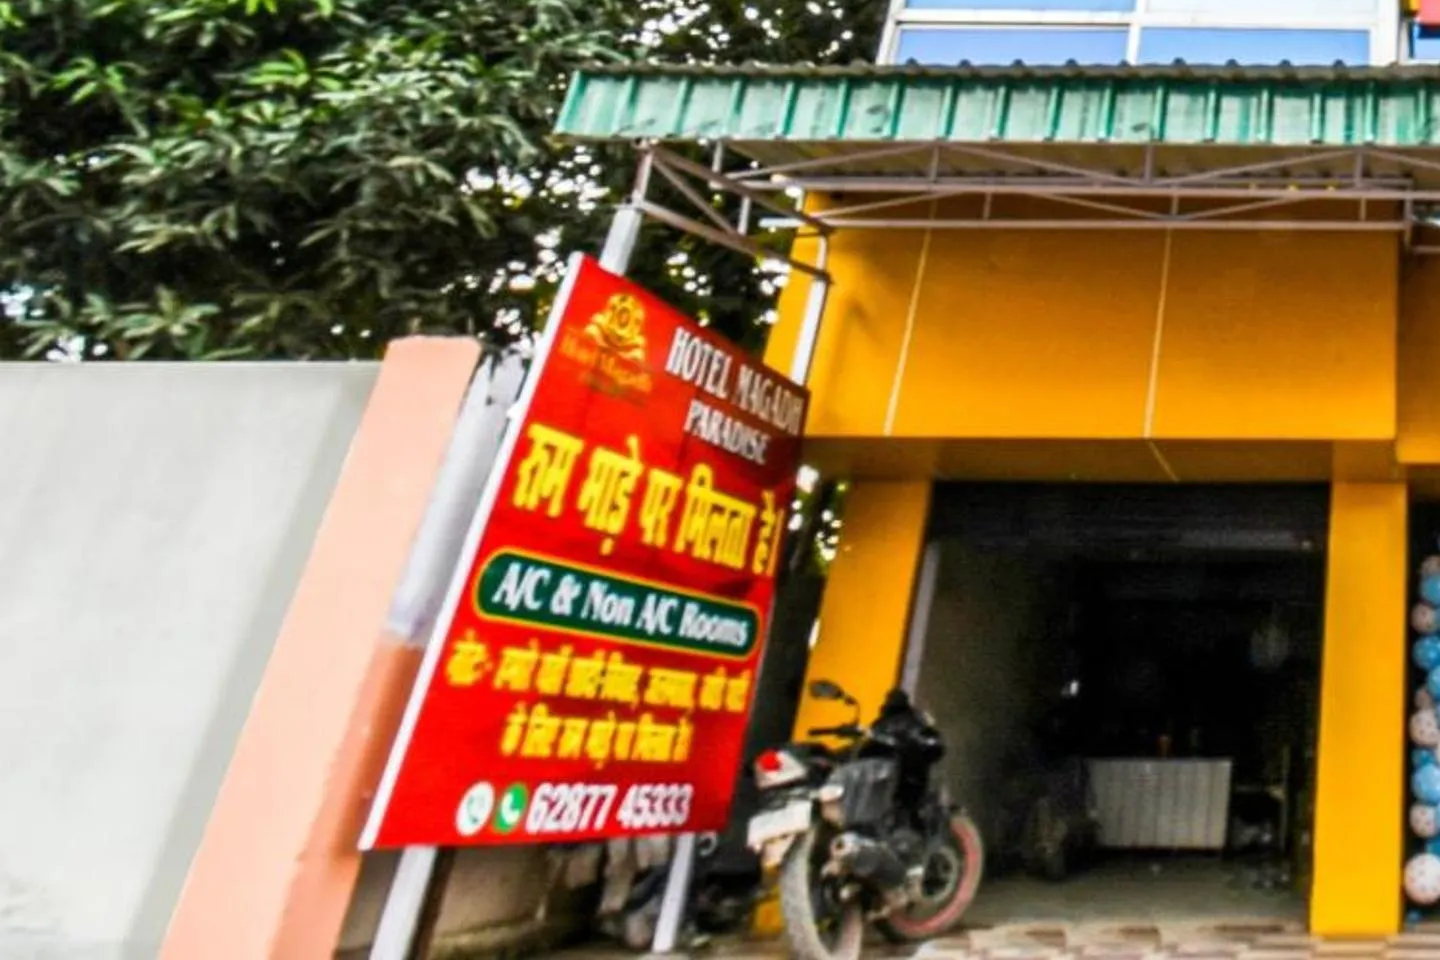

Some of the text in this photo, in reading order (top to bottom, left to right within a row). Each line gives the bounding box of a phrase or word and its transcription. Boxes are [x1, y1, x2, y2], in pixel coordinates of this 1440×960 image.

[664, 326, 732, 400] HOTEL
[683, 399, 771, 465] PARADISE
[640, 468, 683, 547] पर
[674, 463, 756, 569] मिलता
[492, 561, 749, 647] A/C & Non A/C Rooms
[525, 782, 693, 833] 62877 45333
